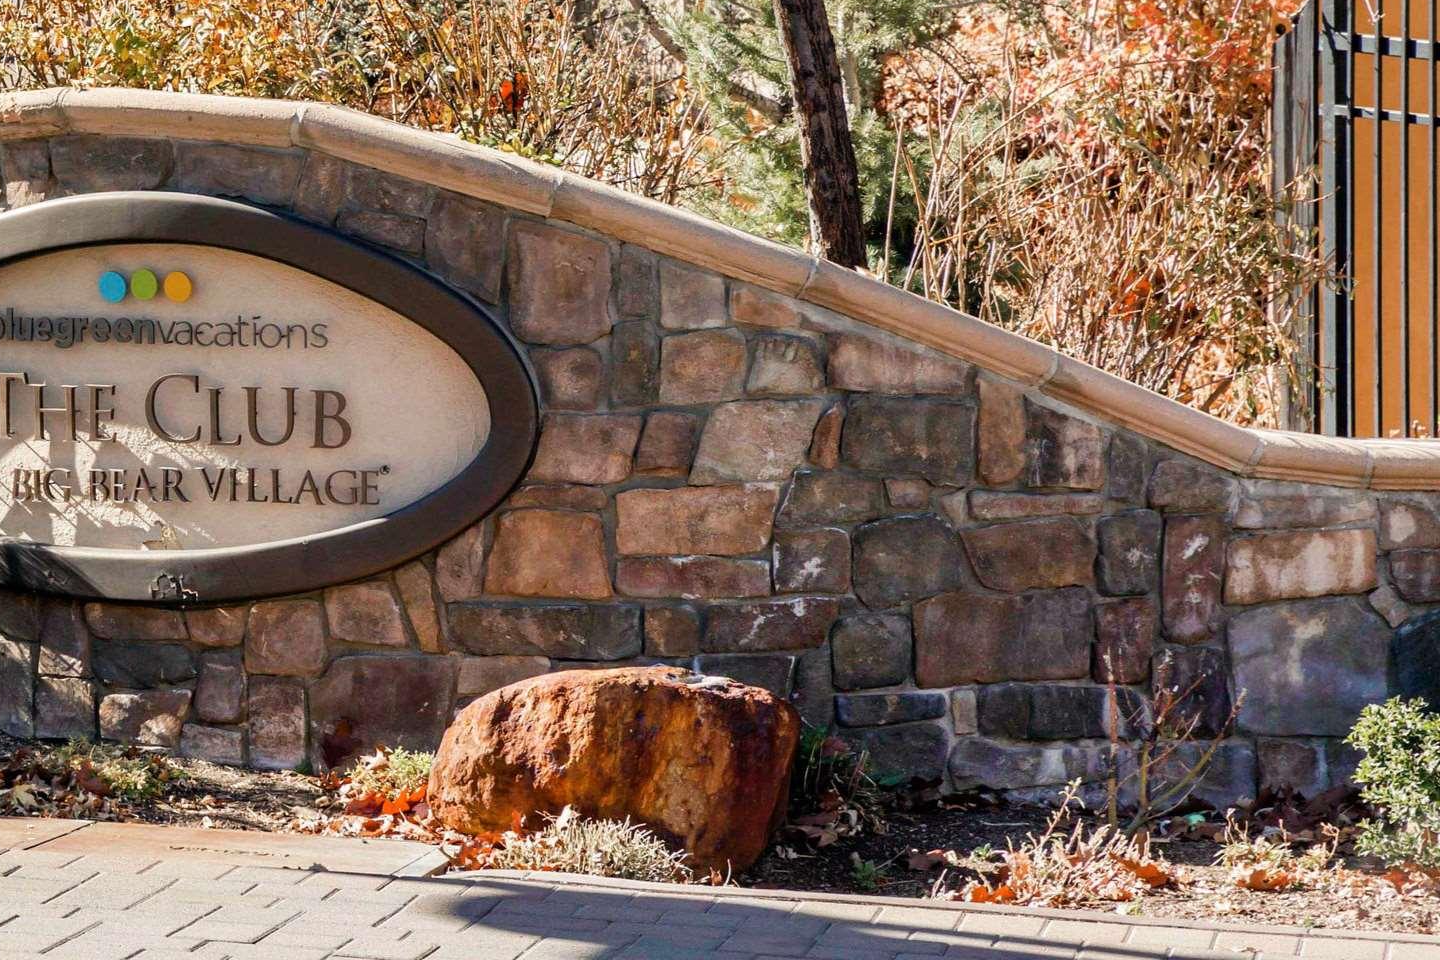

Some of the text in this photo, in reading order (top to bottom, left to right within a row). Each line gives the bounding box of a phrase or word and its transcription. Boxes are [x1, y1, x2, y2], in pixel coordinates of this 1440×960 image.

[145, 373, 352, 449] CLUB
[13, 467, 72, 502] BIG
[89, 467, 190, 503] BEAR
